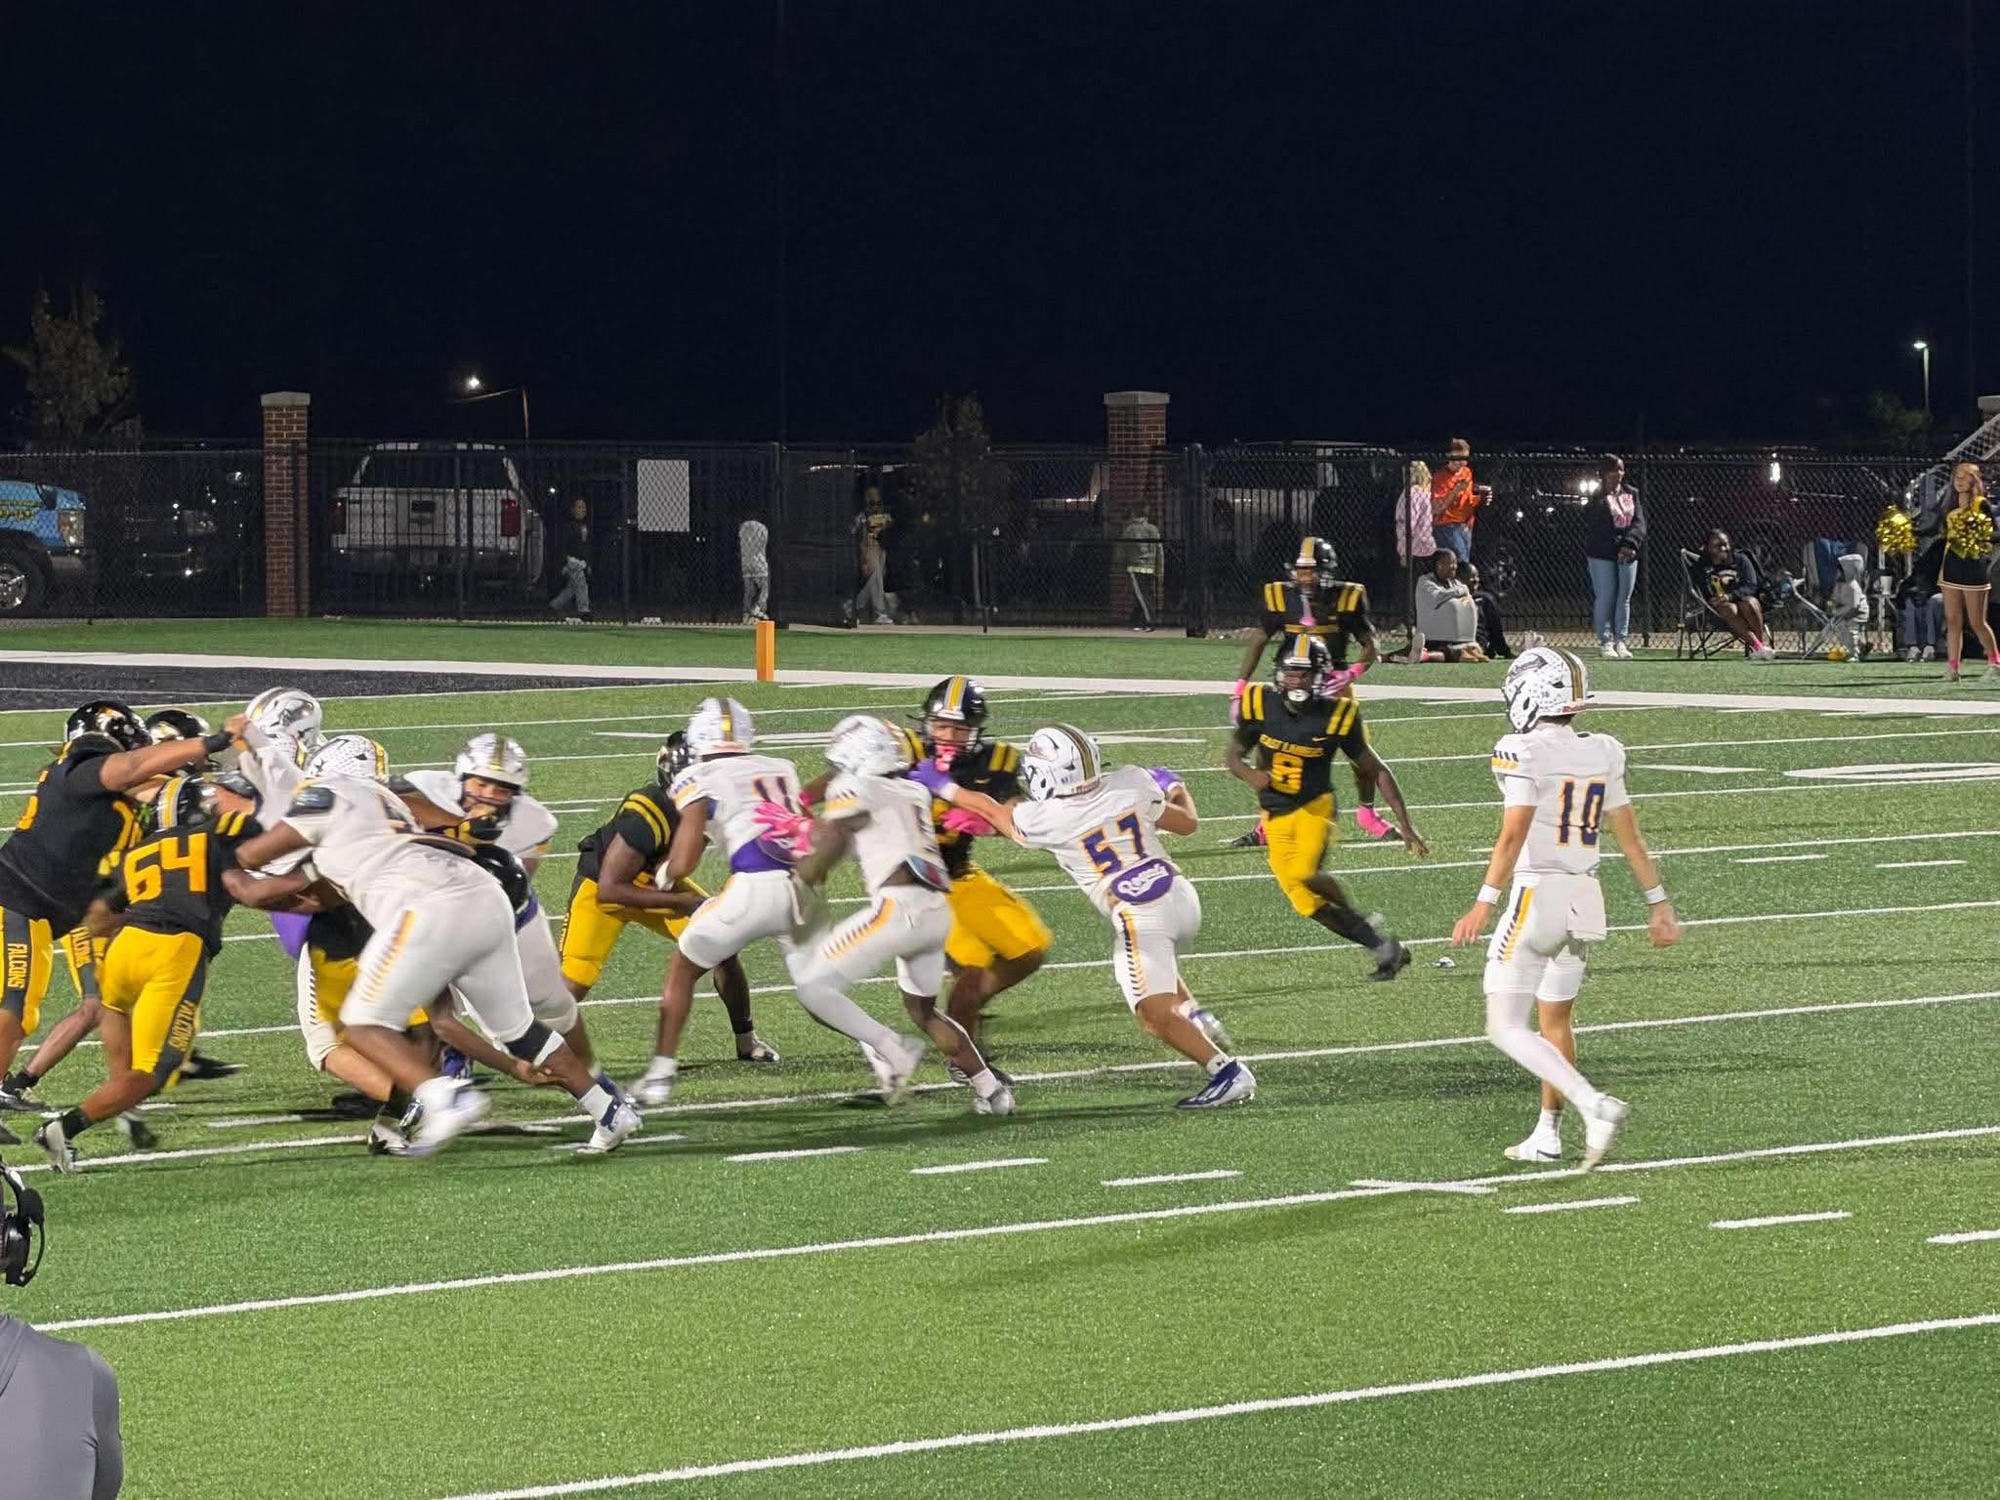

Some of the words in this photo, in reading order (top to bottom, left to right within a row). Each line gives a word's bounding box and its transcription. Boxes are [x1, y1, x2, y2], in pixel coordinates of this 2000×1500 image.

[1079, 810, 1148, 876] 57
[1556, 776, 1606, 848] 10
[124, 832, 208, 904] 64
[7, 943, 28, 989] FALCONS
[168, 1000, 196, 1052] FALCONS
